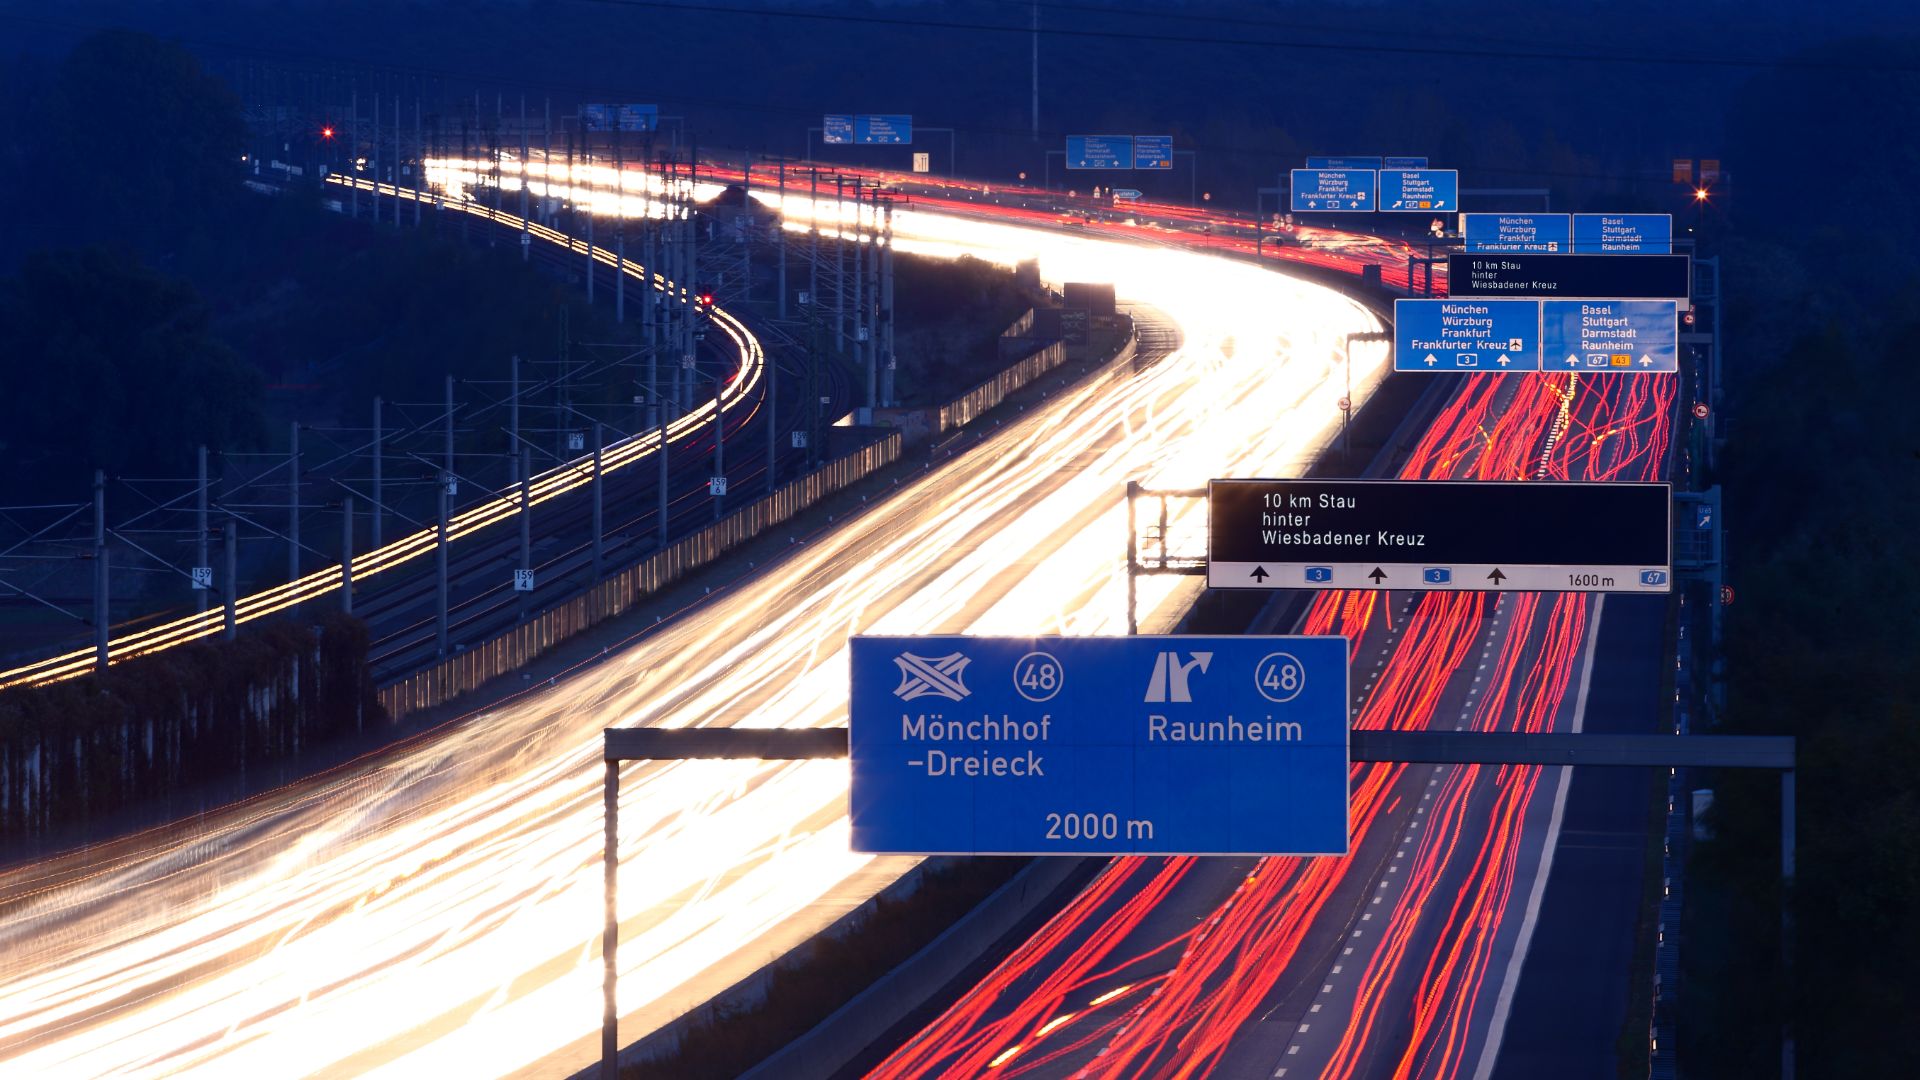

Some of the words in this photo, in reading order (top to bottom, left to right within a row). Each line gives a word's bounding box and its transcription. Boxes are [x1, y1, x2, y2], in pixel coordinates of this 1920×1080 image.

[1602, 217, 1624, 225] Basel
[1499, 226, 1536, 234] Würzburg
[1602, 226, 1636, 234] Stuttgart
[1602, 234, 1642, 242] Darmstadt
[1602, 243, 1640, 251] Raunheim
[1472, 261, 1482, 270] 10
[1485, 261, 1498, 270] km
[1501, 261, 1521, 270] Stau
[1471, 271, 1497, 279] hinter
[1471, 280, 1529, 289] Wiesbadener
[1532, 280, 1557, 289] Kreuz
[1441, 304, 1488, 314] München
[1581, 305, 1611, 315] Basel
[1442, 316, 1493, 328] Würzburg
[1582, 317, 1628, 328] Stuttgart
[1441, 328, 1491, 338] Frankfurt
[1581, 328, 1637, 338] Darmstadt
[1412, 339, 1472, 350] Frankfurter
[1477, 340, 1507, 350] Kreuz
[1581, 340, 1634, 350] Raunheim
[1464, 355, 1470, 364] 3
[1592, 356, 1603, 364] 67
[1615, 356, 1626, 365] 43
[1263, 493, 1282, 508] 10
[1290, 494, 1312, 508] km
[1319, 494, 1356, 509] Stau
[1263, 512, 1311, 527] hinter
[1262, 530, 1371, 546] Wiesbadener
[1378, 531, 1425, 546] Kreuz
[194, 568, 211, 577] 159
[516, 570, 533, 579] 159
[1316, 569, 1323, 580] 3
[1434, 571, 1441, 581] 3
[1647, 572, 1660, 583] 67
[521, 580, 527, 588] 4
[1569, 574, 1599, 587] 1600
[1603, 577, 1615, 587] m
[1021, 663, 1056, 690] 48
[1262, 664, 1298, 691] 48
[902, 714, 1051, 741] Mönchhof
[1148, 714, 1302, 742] Raunheim
[907, 749, 1044, 777] -Dreieck
[1045, 812, 1118, 840] 2000
[1127, 820, 1153, 840] m
